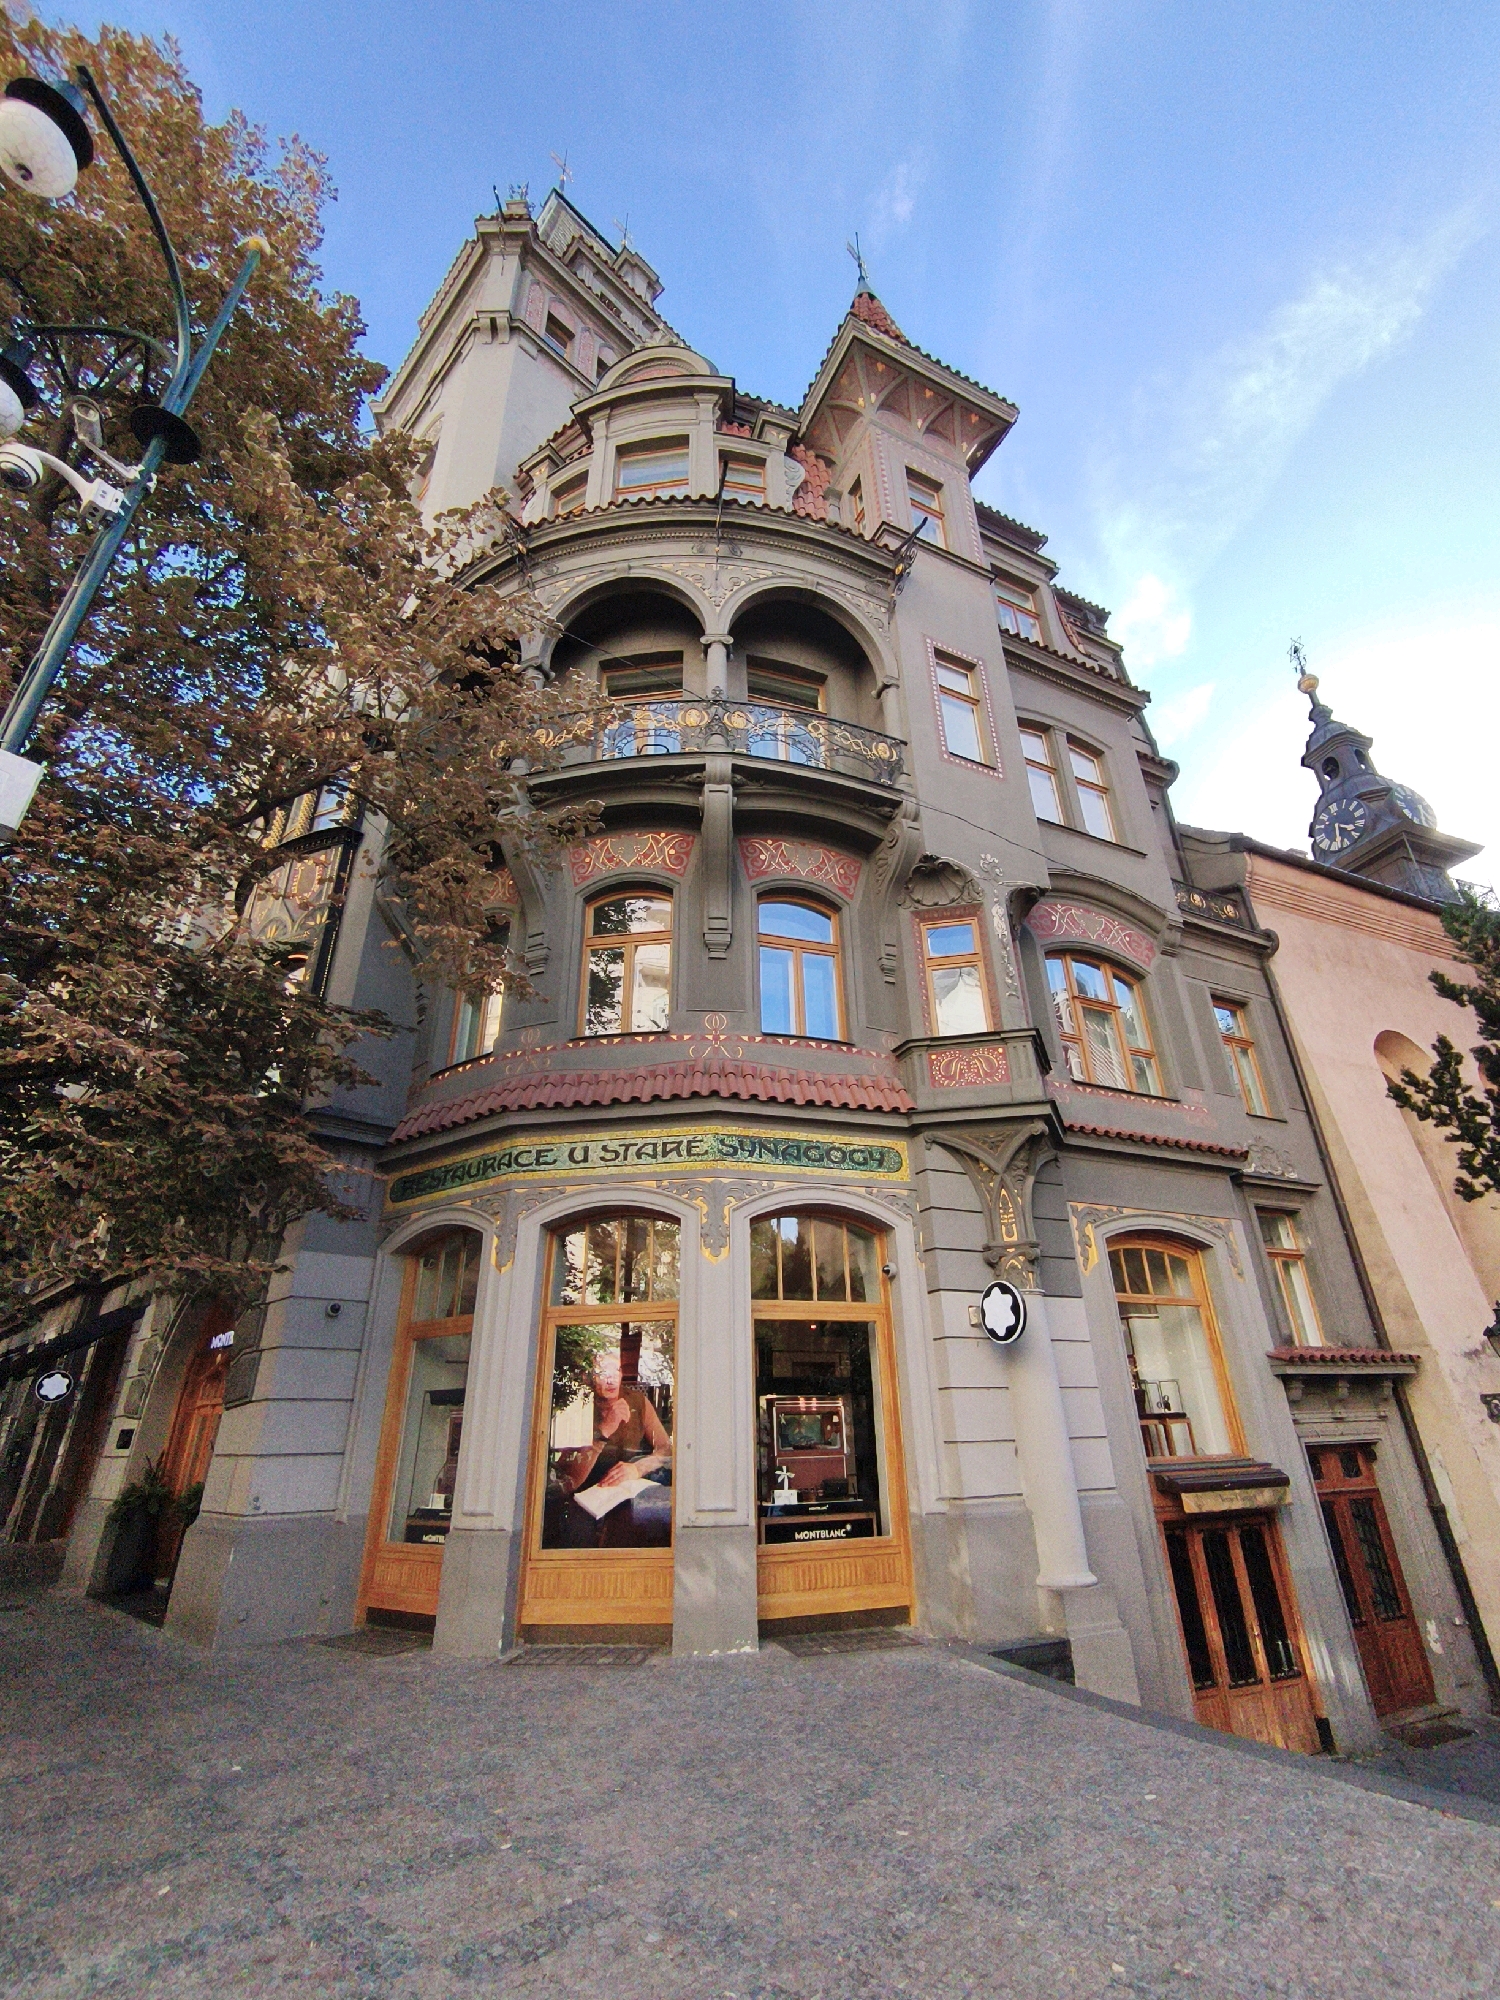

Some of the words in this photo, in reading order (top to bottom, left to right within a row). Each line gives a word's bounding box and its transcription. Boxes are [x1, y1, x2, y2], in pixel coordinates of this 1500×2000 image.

[401, 1148, 558, 1193] RESTAURACE
[567, 1145, 589, 1164] U
[599, 1137, 709, 1162] STARÉ
[718, 1137, 885, 1168] SYNAGOGY
[794, 1528, 847, 1540] MONTBLANC
